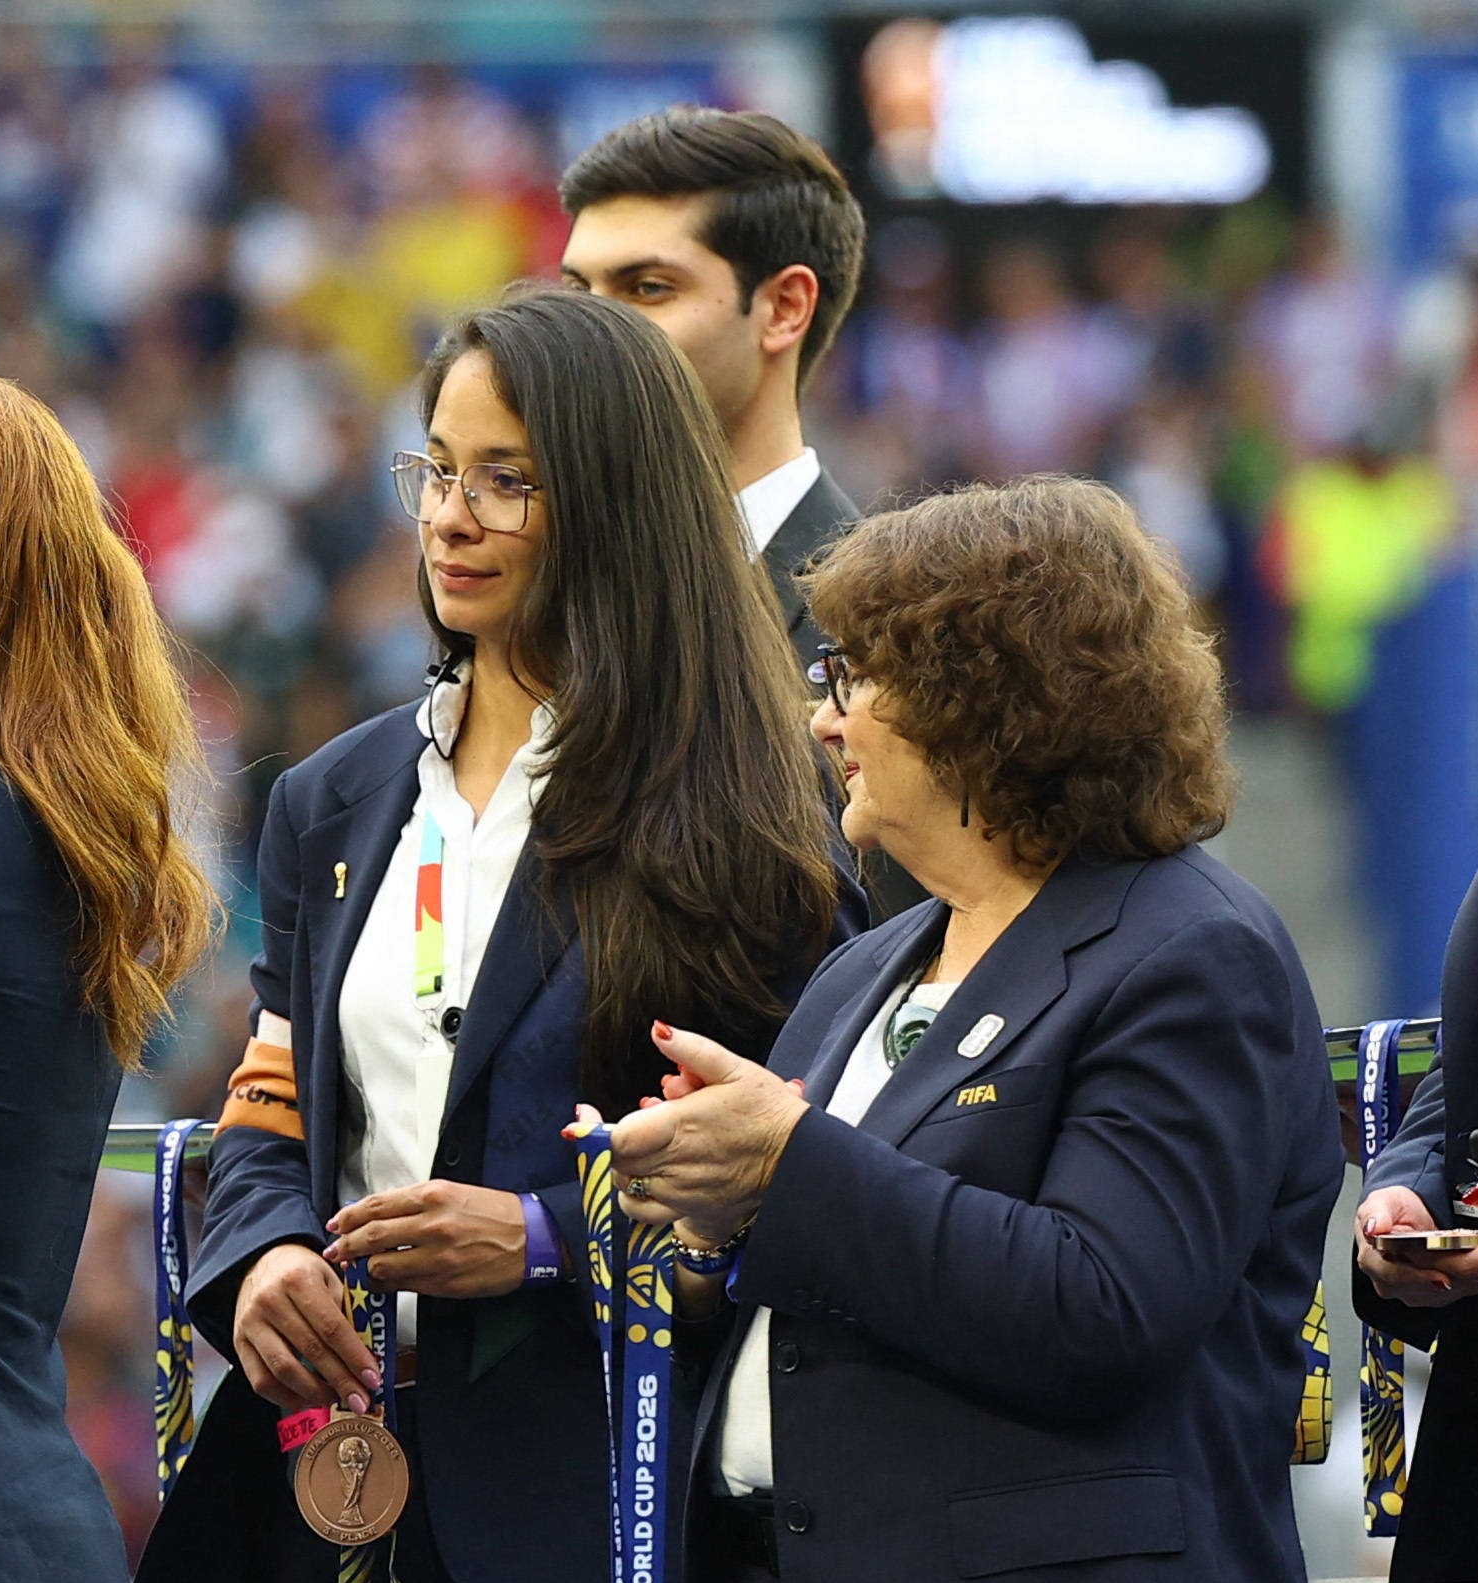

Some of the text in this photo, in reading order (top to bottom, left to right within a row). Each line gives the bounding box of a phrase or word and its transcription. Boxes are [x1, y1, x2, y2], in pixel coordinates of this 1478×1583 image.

[956, 1084, 997, 1107] FIFA
[1363, 1023, 1388, 1103] 2026
[1363, 1107, 1377, 1154] CUP
[161, 1131, 180, 1215] WORLD
[635, 1373, 659, 1463] 2026
[634, 1466, 656, 1518] CUP
